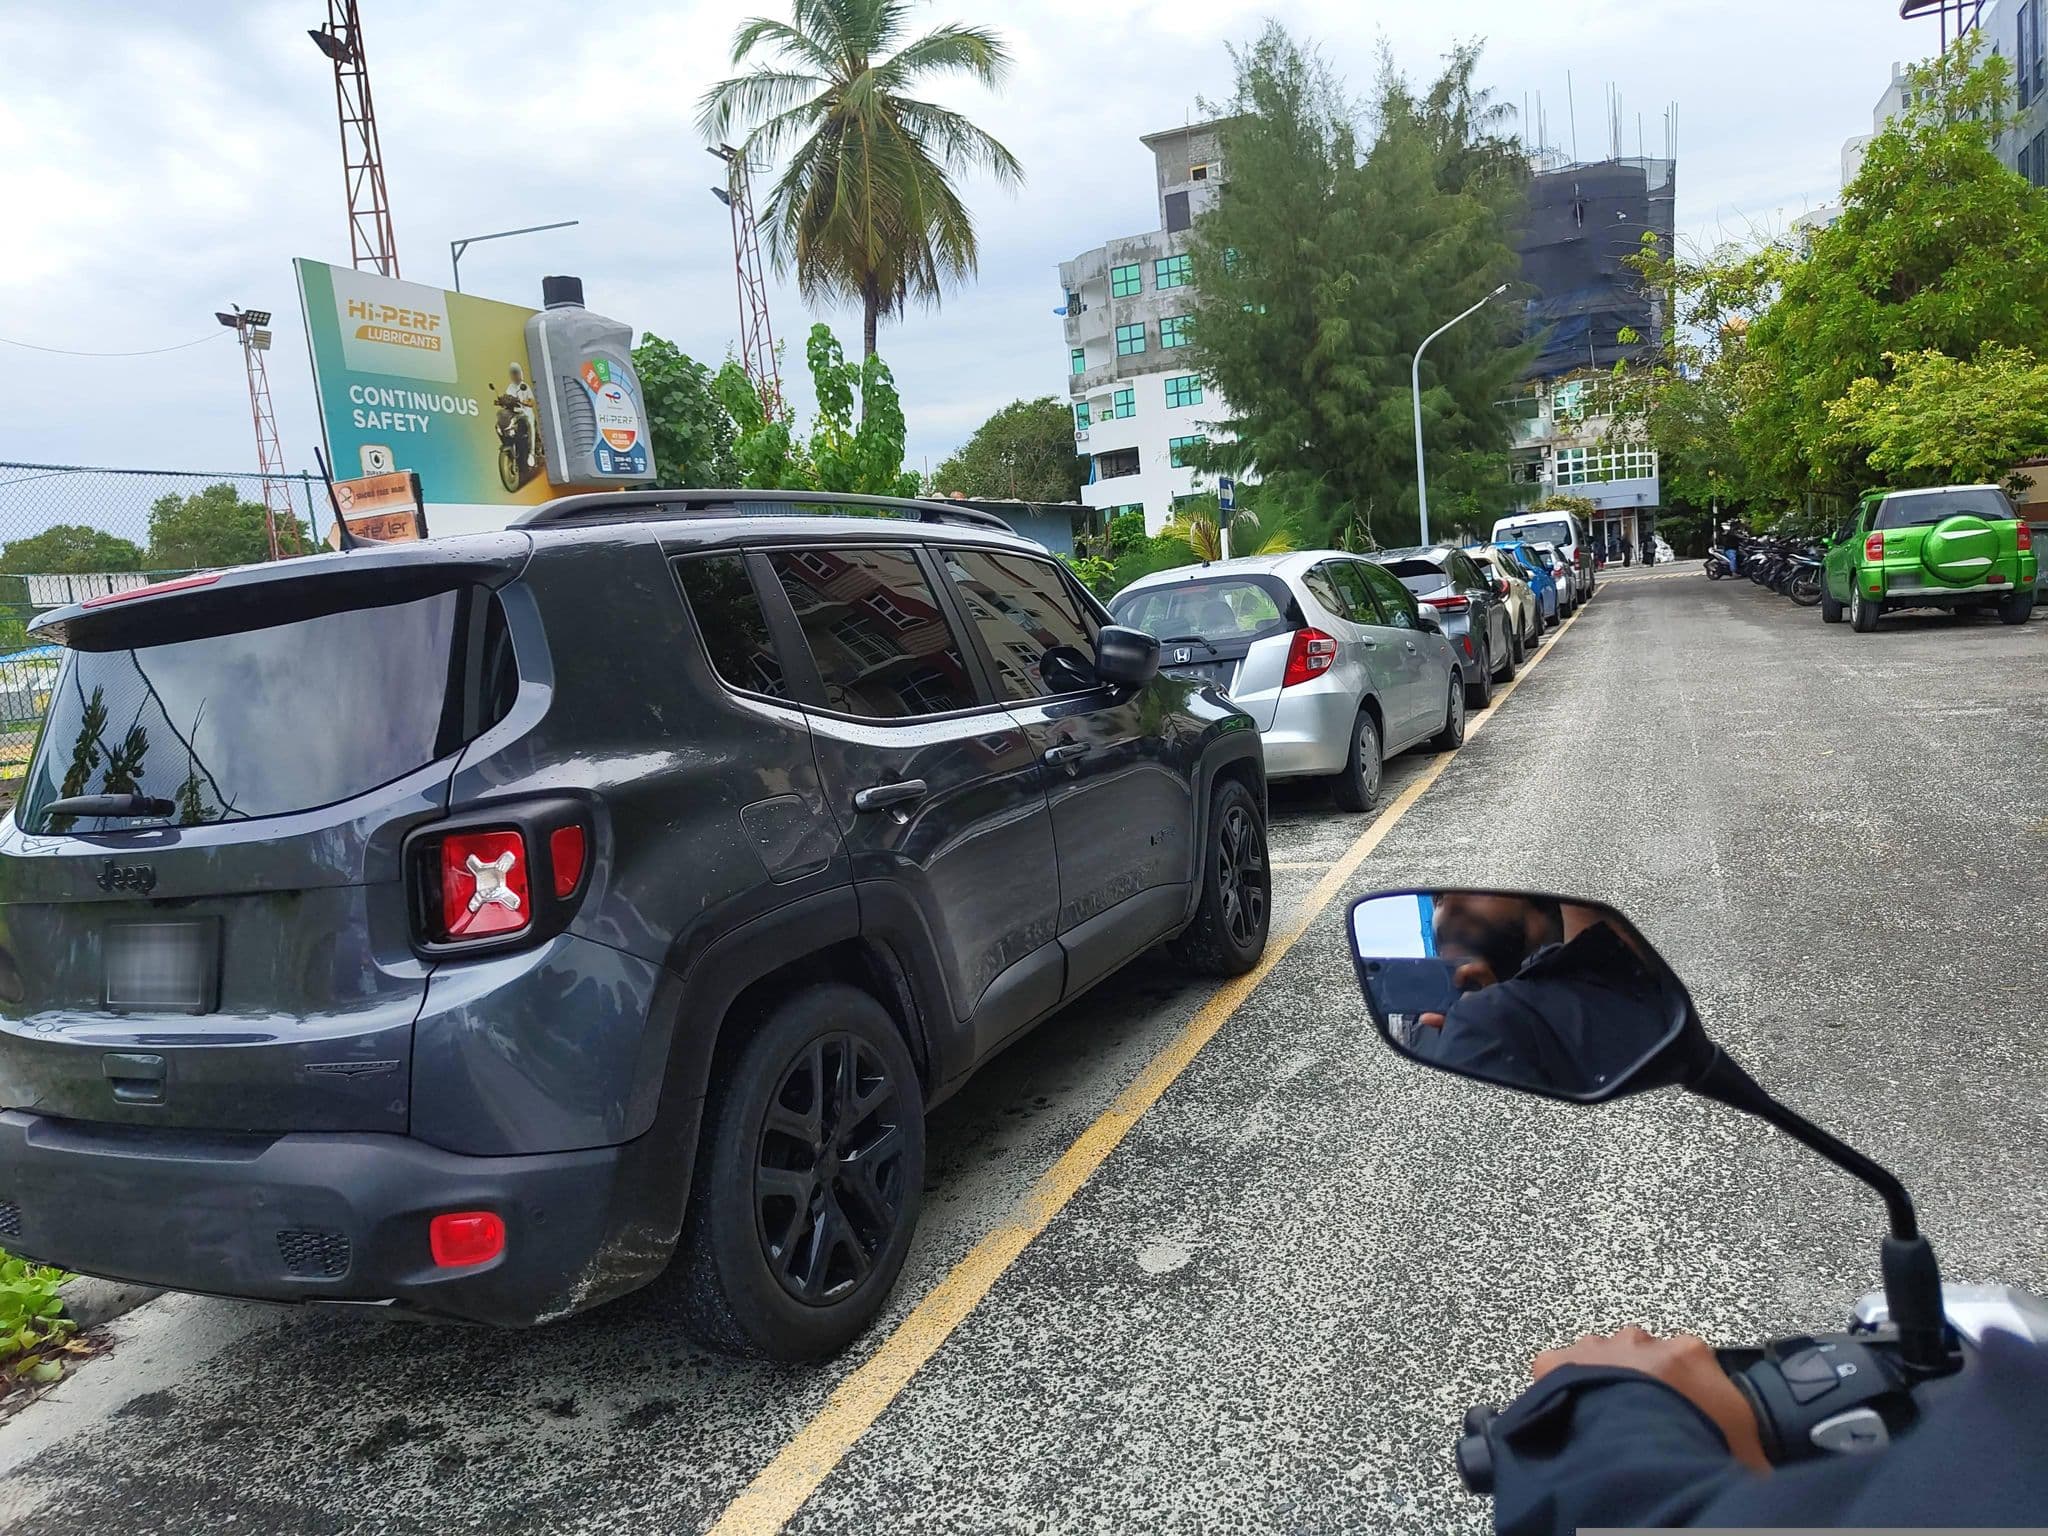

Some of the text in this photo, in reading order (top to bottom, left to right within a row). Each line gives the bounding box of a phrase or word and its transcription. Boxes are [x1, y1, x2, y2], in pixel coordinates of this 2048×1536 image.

[348, 299, 440, 331] Hi-PERF
[367, 328, 439, 349] LUBRICANTS
[349, 384, 480, 417] CONTINUOUS
[352, 408, 430, 434] SAFETY
[96, 858, 156, 895] Jeep
